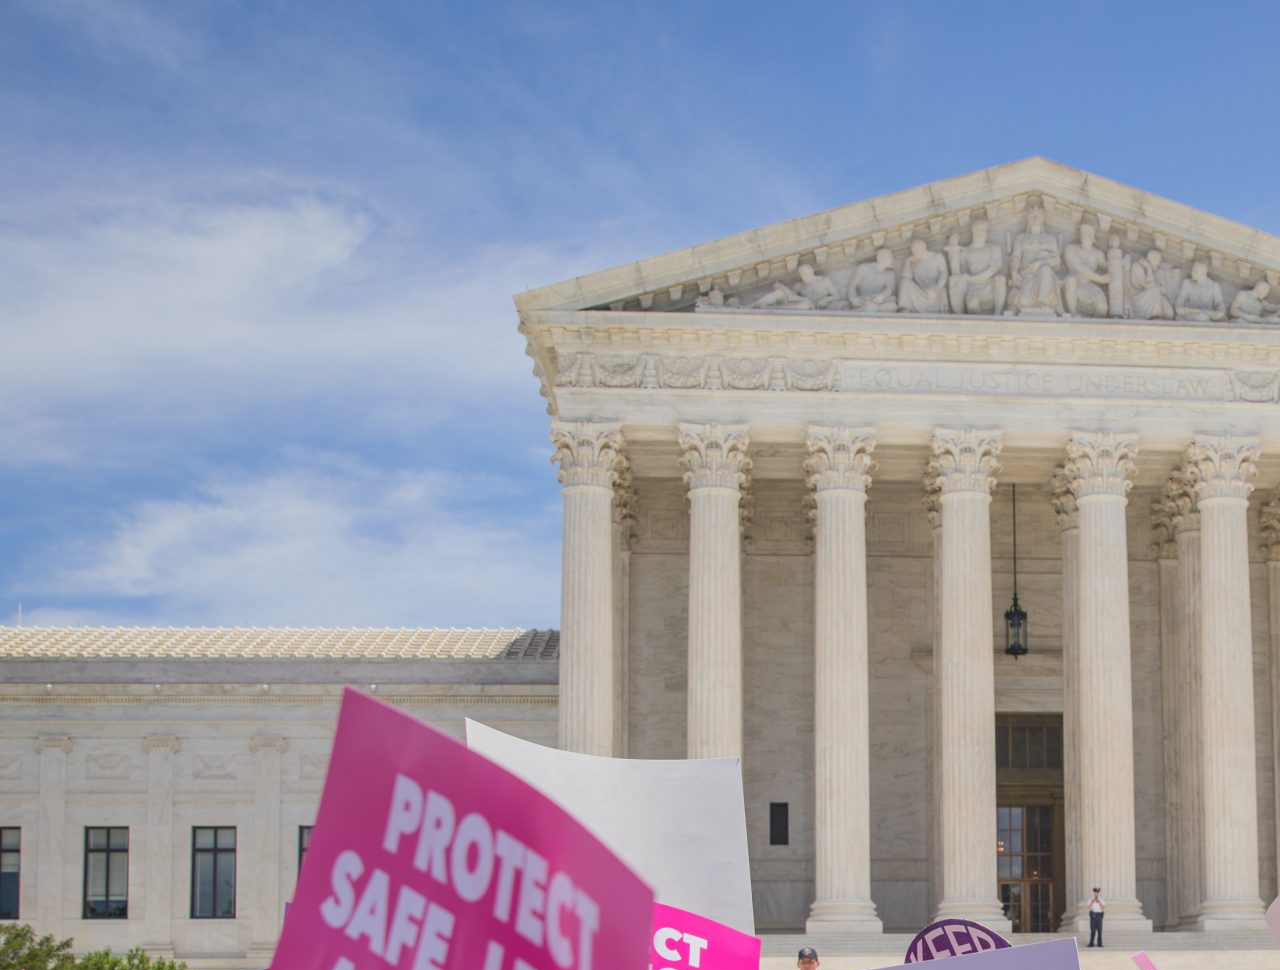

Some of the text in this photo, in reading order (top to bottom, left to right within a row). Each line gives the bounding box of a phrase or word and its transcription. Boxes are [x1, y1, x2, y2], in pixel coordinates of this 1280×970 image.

[858, 368, 1210, 396] EQUAL JUSTICE UNDER LAW
